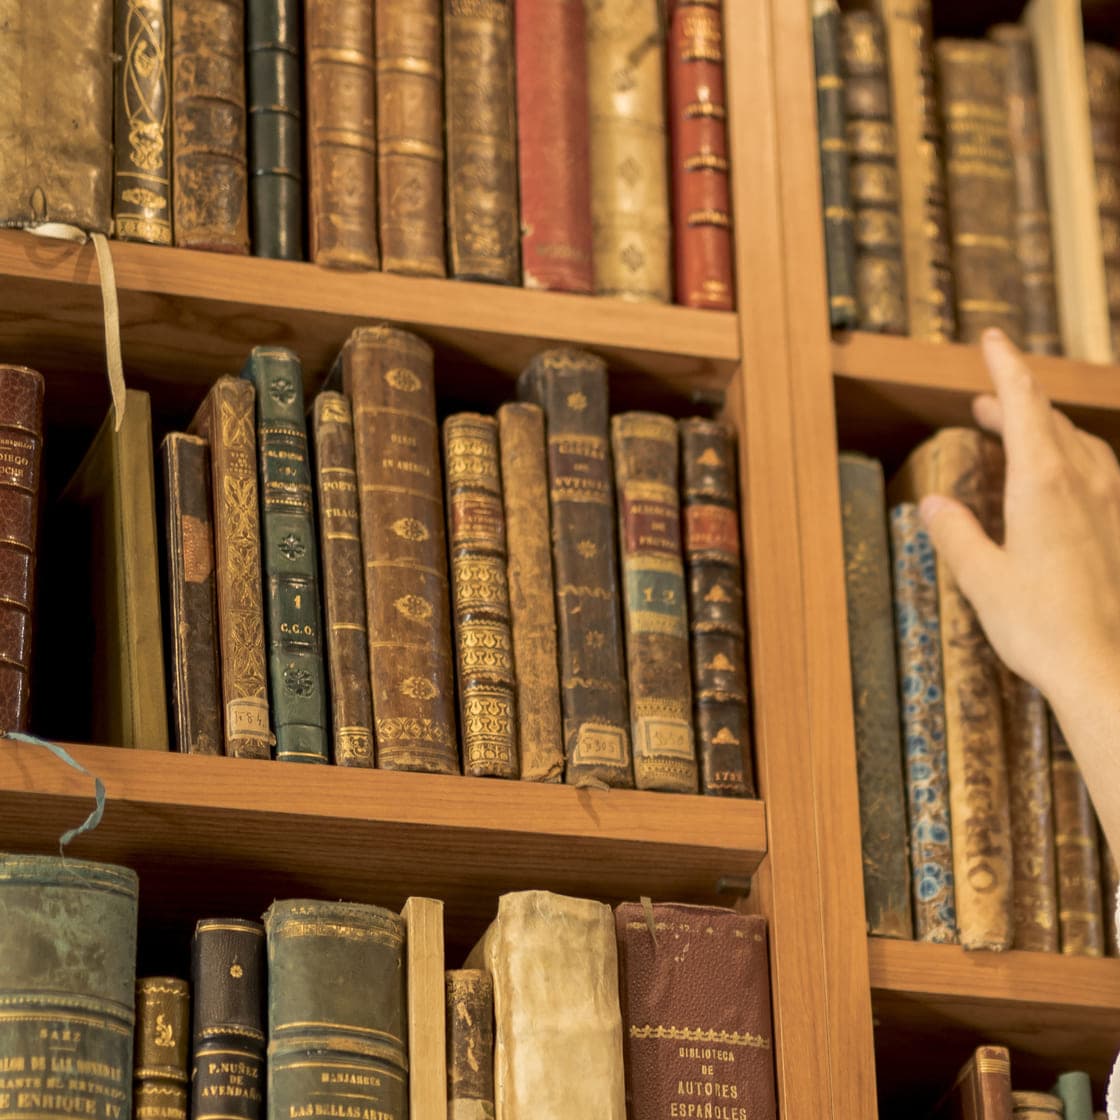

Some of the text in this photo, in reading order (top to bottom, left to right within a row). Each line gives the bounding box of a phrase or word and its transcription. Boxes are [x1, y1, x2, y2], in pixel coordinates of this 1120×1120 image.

[679, 1047, 735, 1062] BIBLIOTECA
[701, 1065, 714, 1076] DE
[677, 1081, 738, 1099] AUTORES
[17, 1093, 97, 1115] ENRIQUE
[105, 1103, 121, 1119] IV
[290, 1104, 313, 1118] LAS
[315, 1103, 361, 1119] BELLAS
